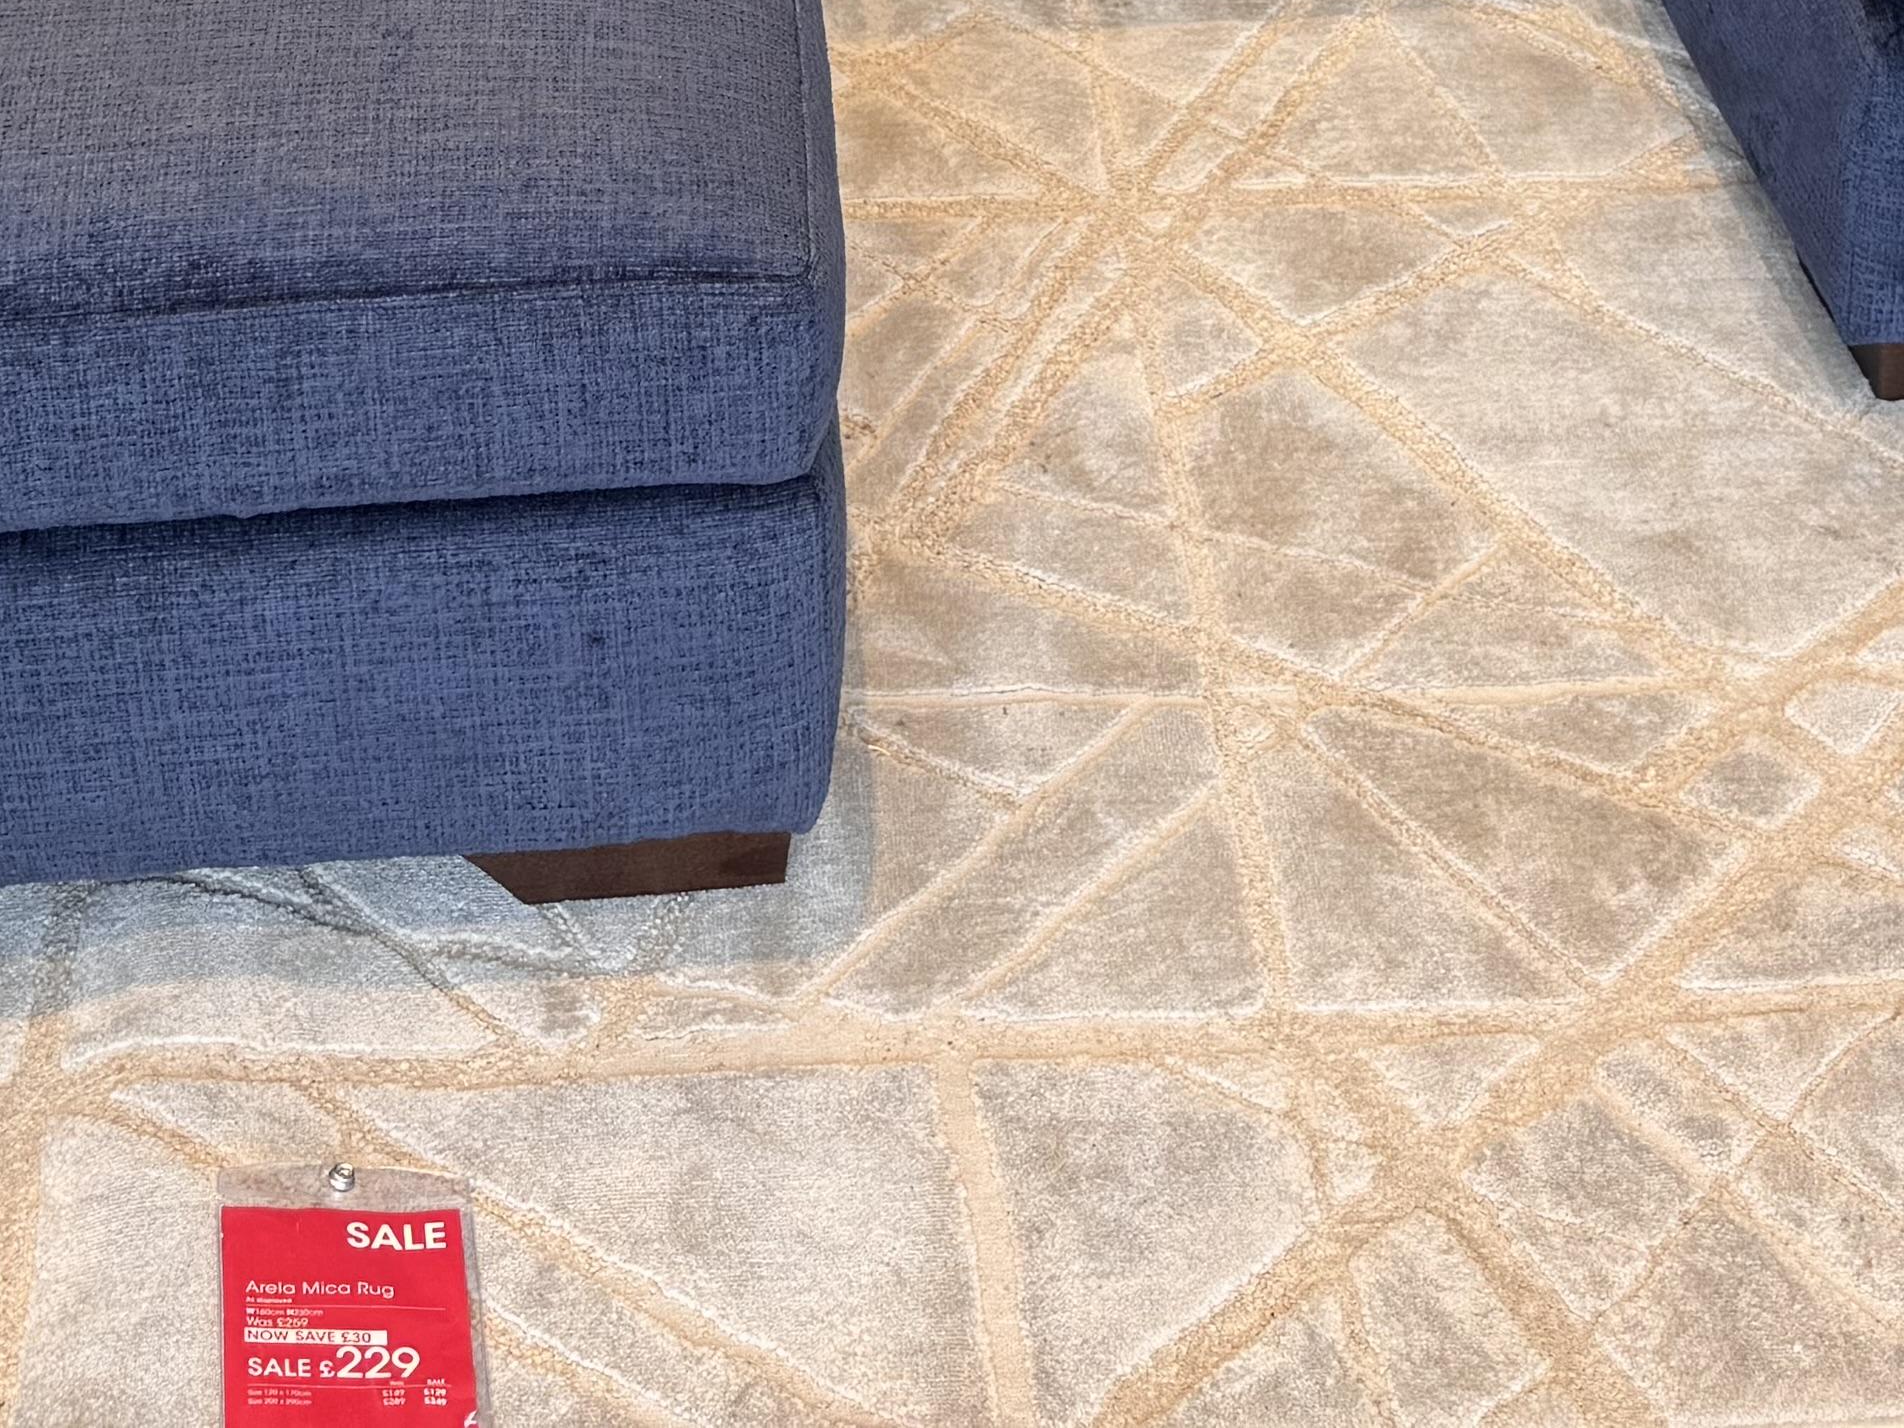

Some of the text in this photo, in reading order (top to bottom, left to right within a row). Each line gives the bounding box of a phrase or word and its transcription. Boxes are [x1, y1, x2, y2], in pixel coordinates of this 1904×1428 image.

[346, 1221, 447, 1250] SALE
[245, 1279, 395, 1299] Arela Mica Rug
[246, 1317, 273, 1327] Was
[247, 1330, 372, 1343] NOW SAVE £30
[247, 1345, 421, 1379] SALE £229
